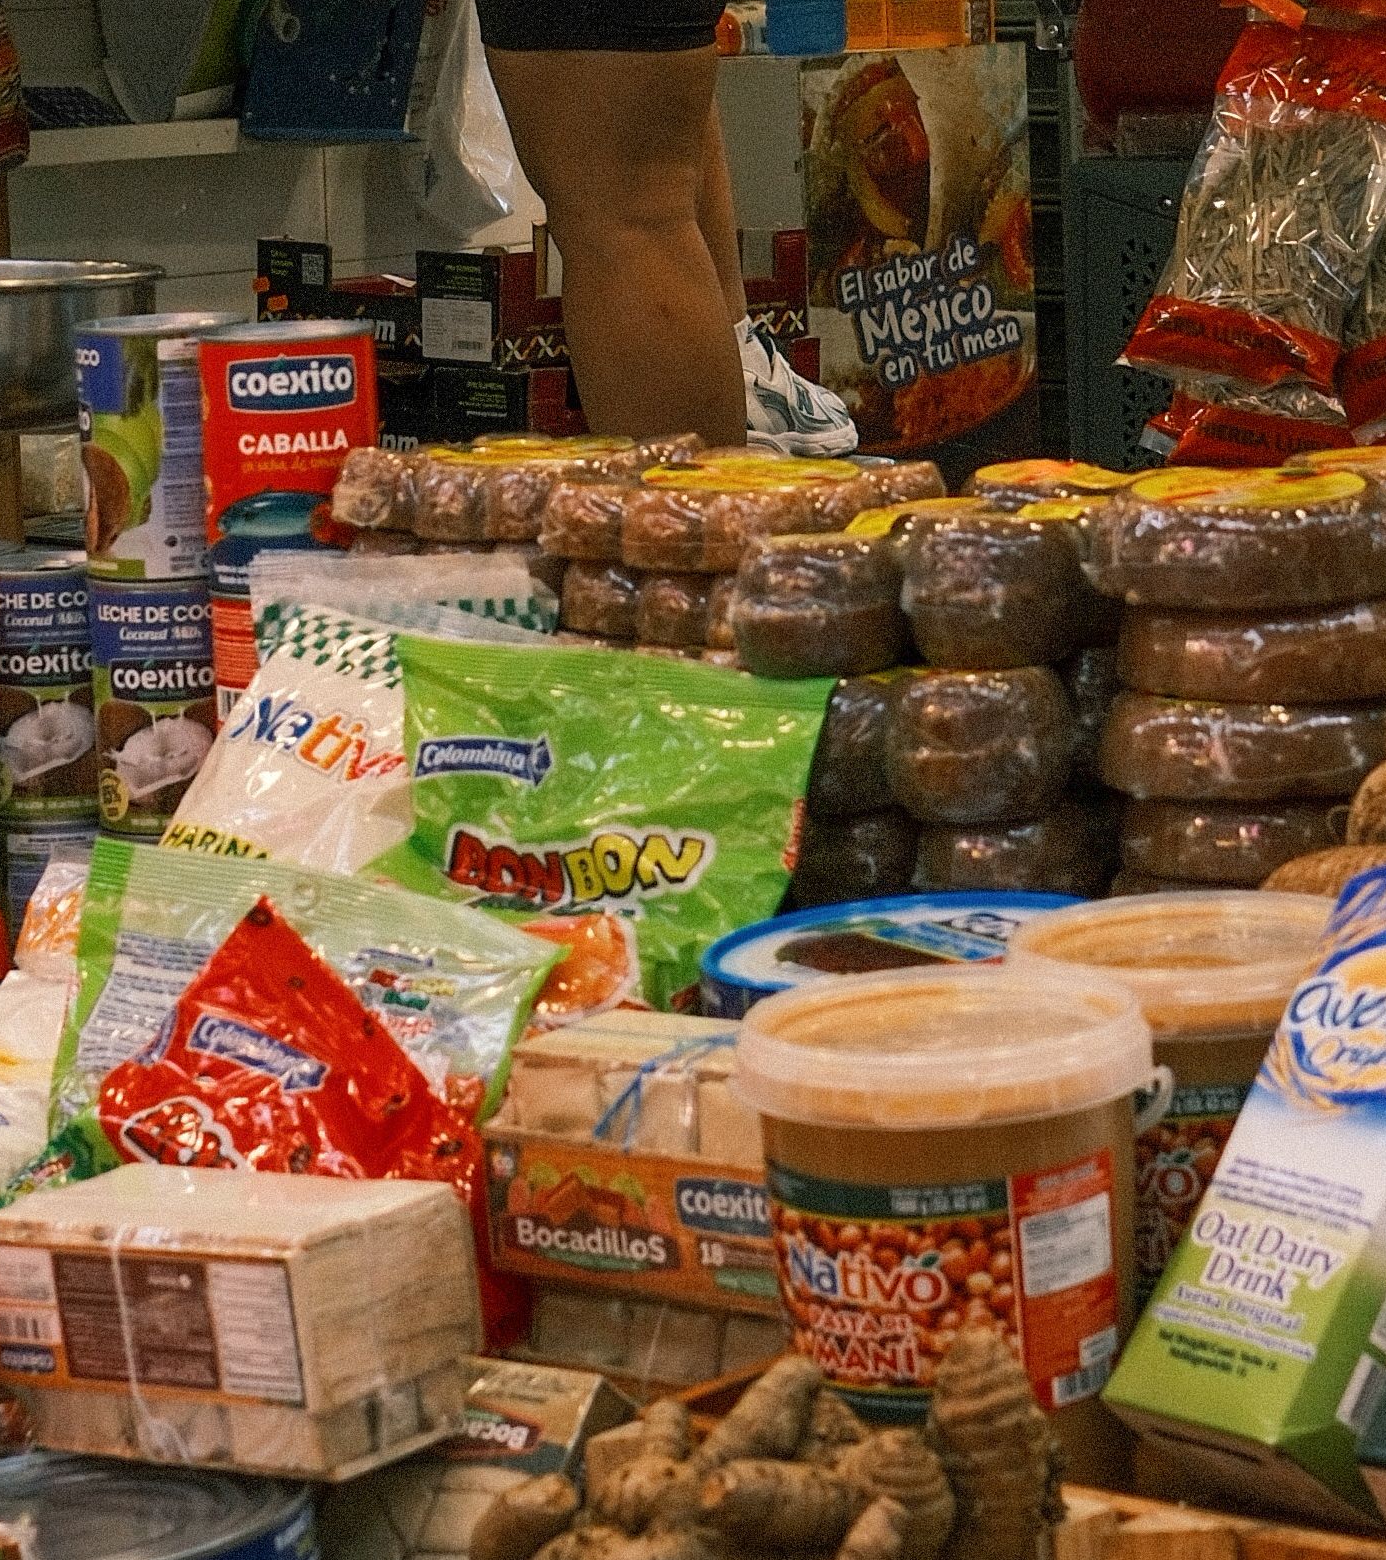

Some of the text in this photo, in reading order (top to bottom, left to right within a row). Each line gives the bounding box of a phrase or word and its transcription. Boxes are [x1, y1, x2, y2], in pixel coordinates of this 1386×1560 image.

[839, 238, 977, 305] El sabor de
[859, 283, 993, 354] México
[230, 360, 354, 402] coexito
[885, 322, 1021, 382] en tu mesa
[238, 429, 348, 457] CABALLA
[98, 604, 171, 624] LECHE DE
[113, 660, 213, 692] coexito
[564, 830, 705, 900] BON
[1193, 1208, 1345, 1286] Oat Dairy
[1201, 1250, 1292, 1306] Drink
